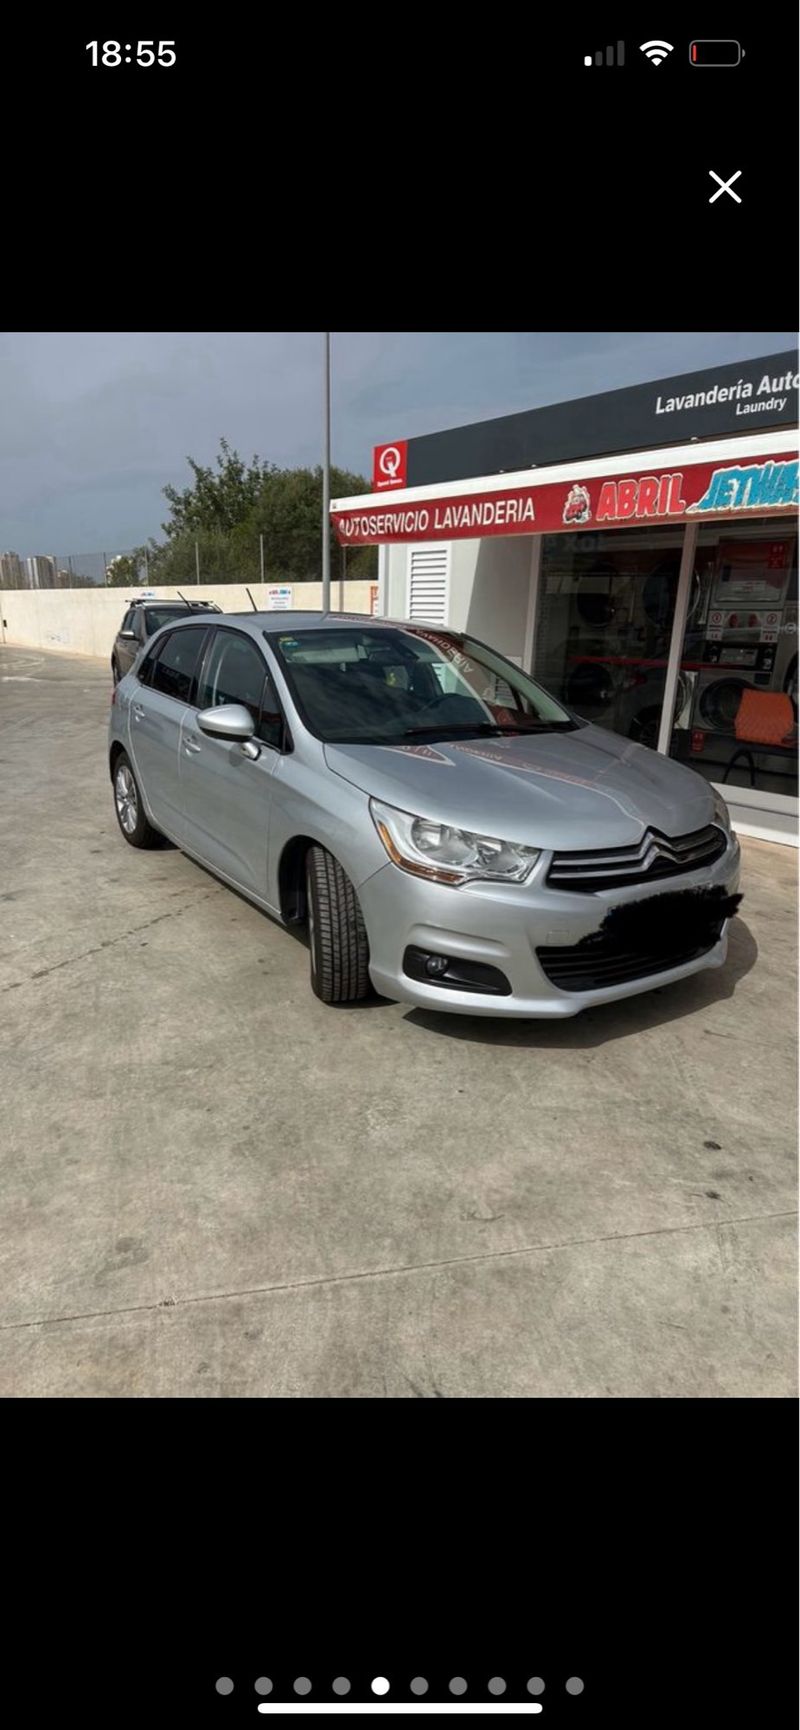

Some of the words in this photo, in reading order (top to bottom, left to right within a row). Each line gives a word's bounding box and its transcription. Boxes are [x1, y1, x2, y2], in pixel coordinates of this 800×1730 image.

[655, 379, 753, 414] Lavandería
[736, 397, 787, 415] Laundry
[596, 473, 686, 520] ABRIL
[339, 510, 429, 537] AUTOSERVICIO
[434, 497, 536, 529] LAVANDERIA
